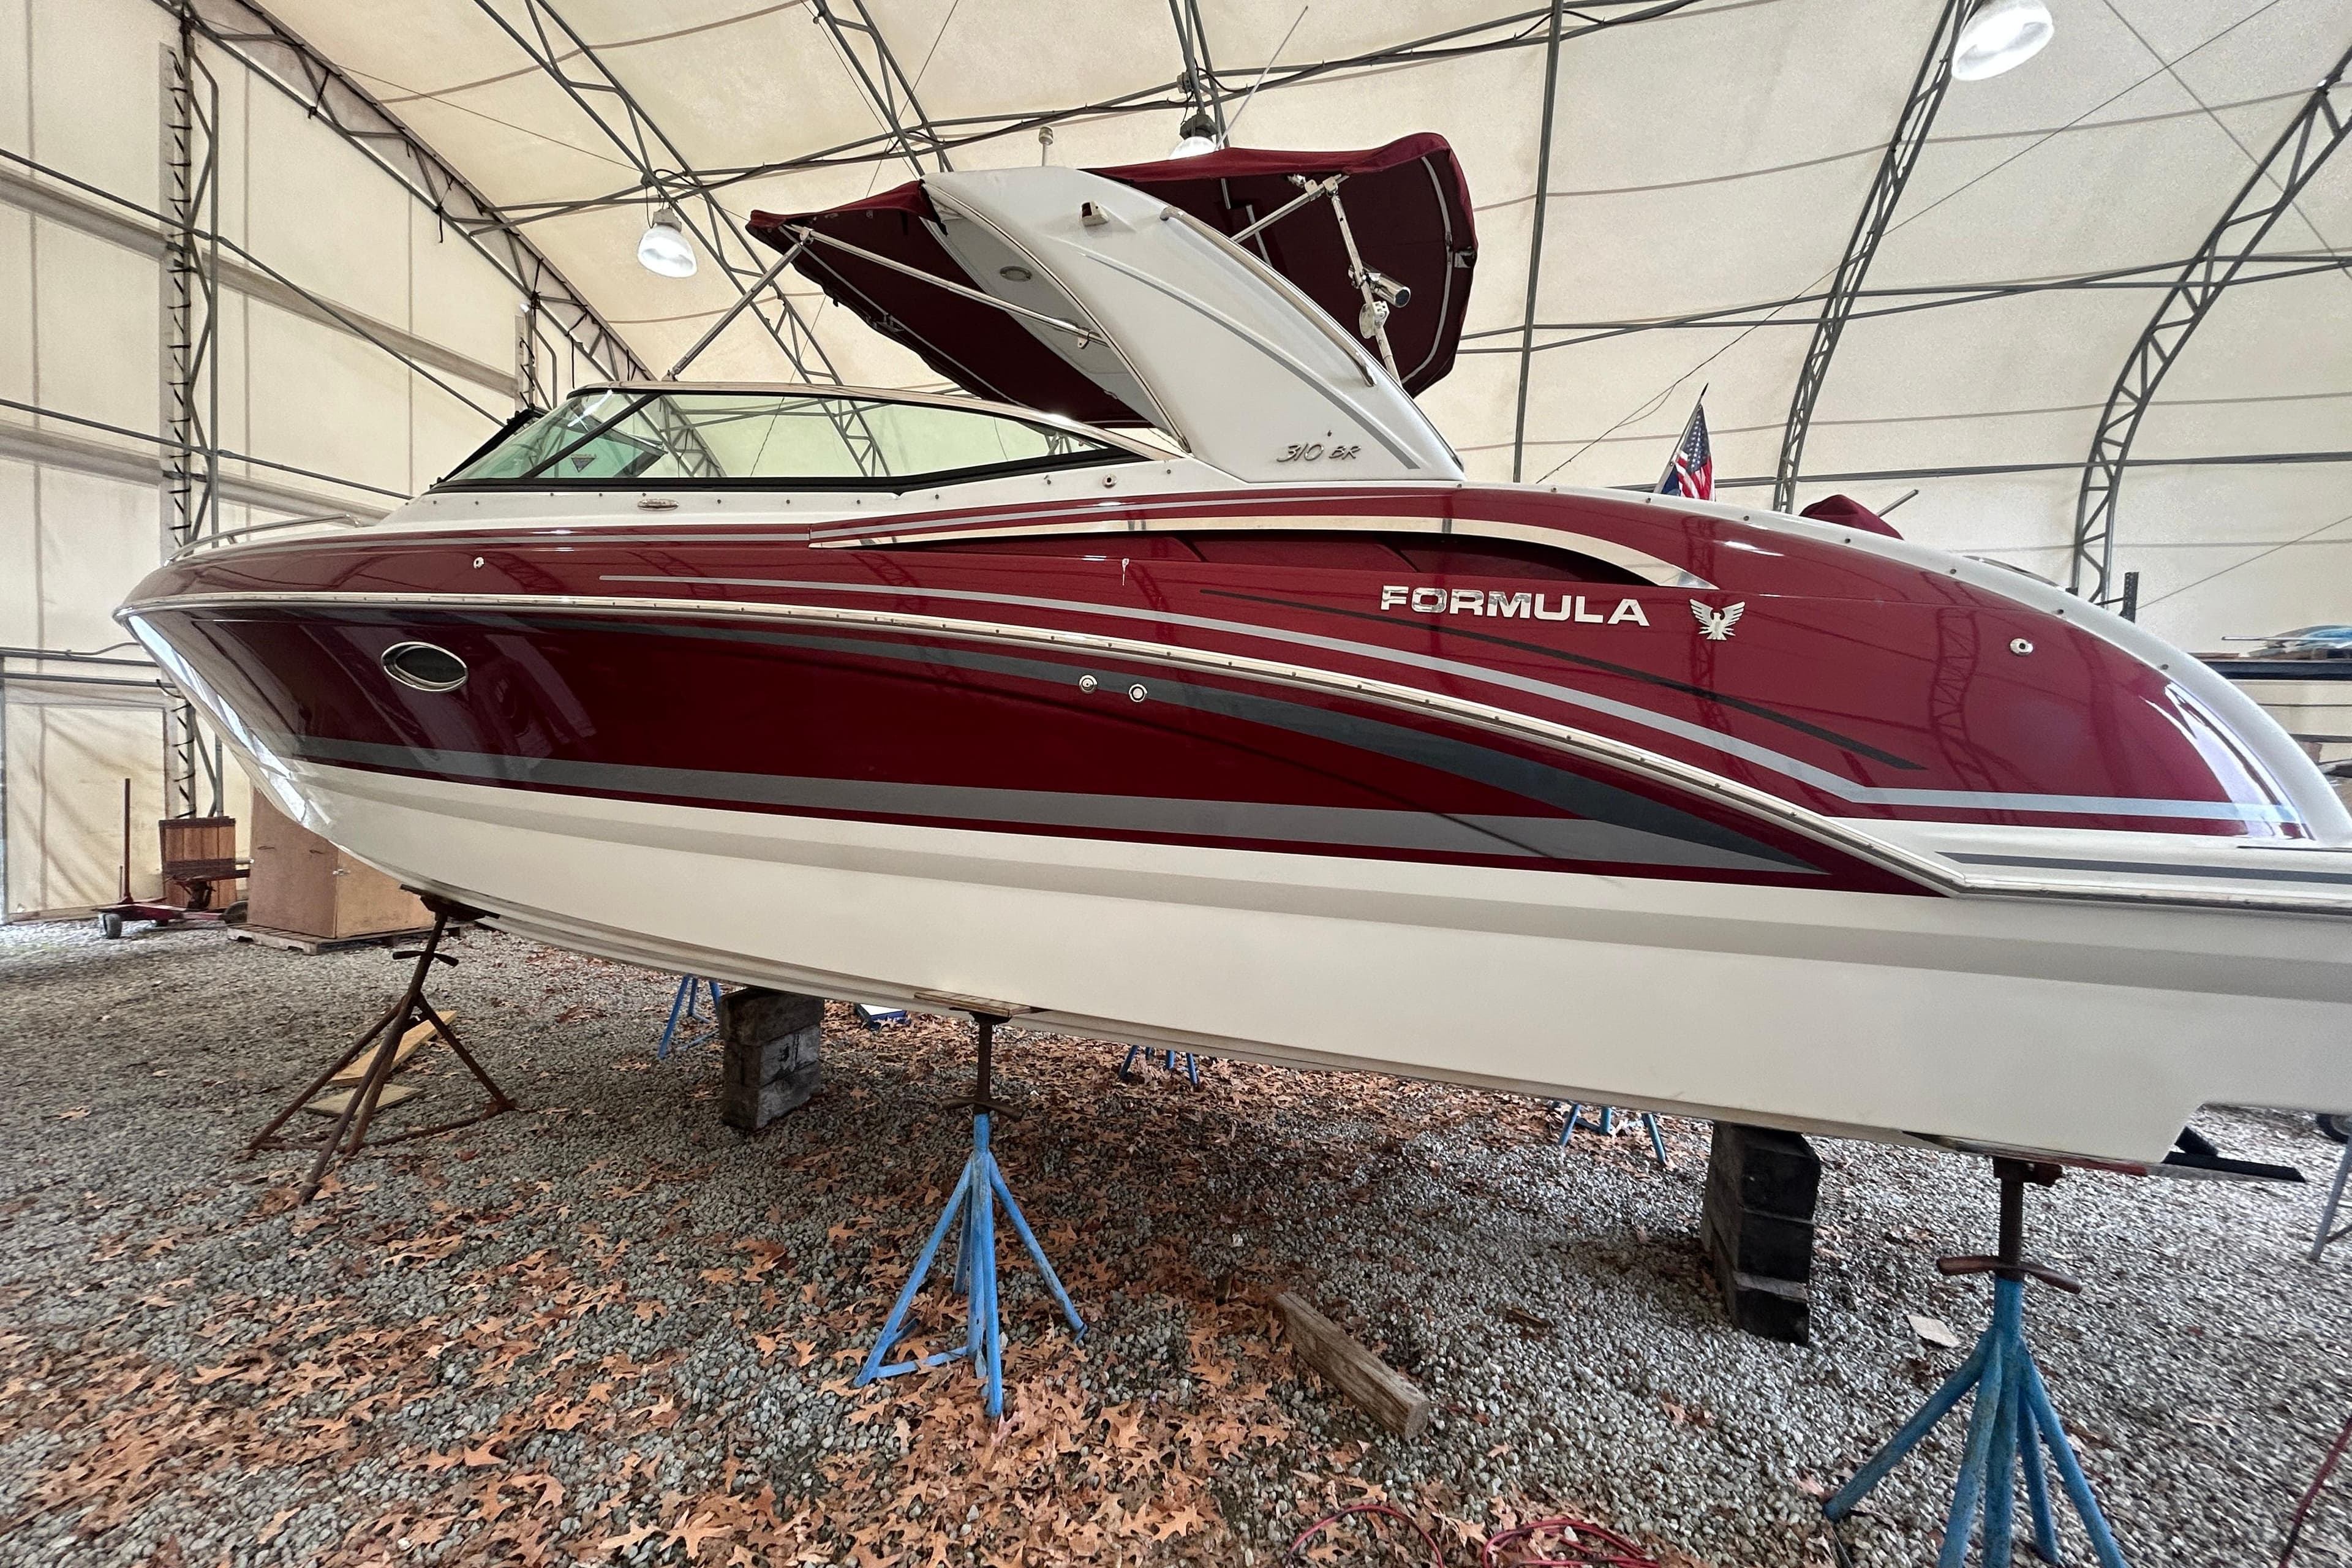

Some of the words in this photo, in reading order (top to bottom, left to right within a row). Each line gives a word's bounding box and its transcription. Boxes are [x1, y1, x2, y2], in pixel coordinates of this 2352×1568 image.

[1276, 443, 1324, 462] 310
[1328, 445, 1362, 460] BR
[1380, 584, 1651, 627] FORMULA
